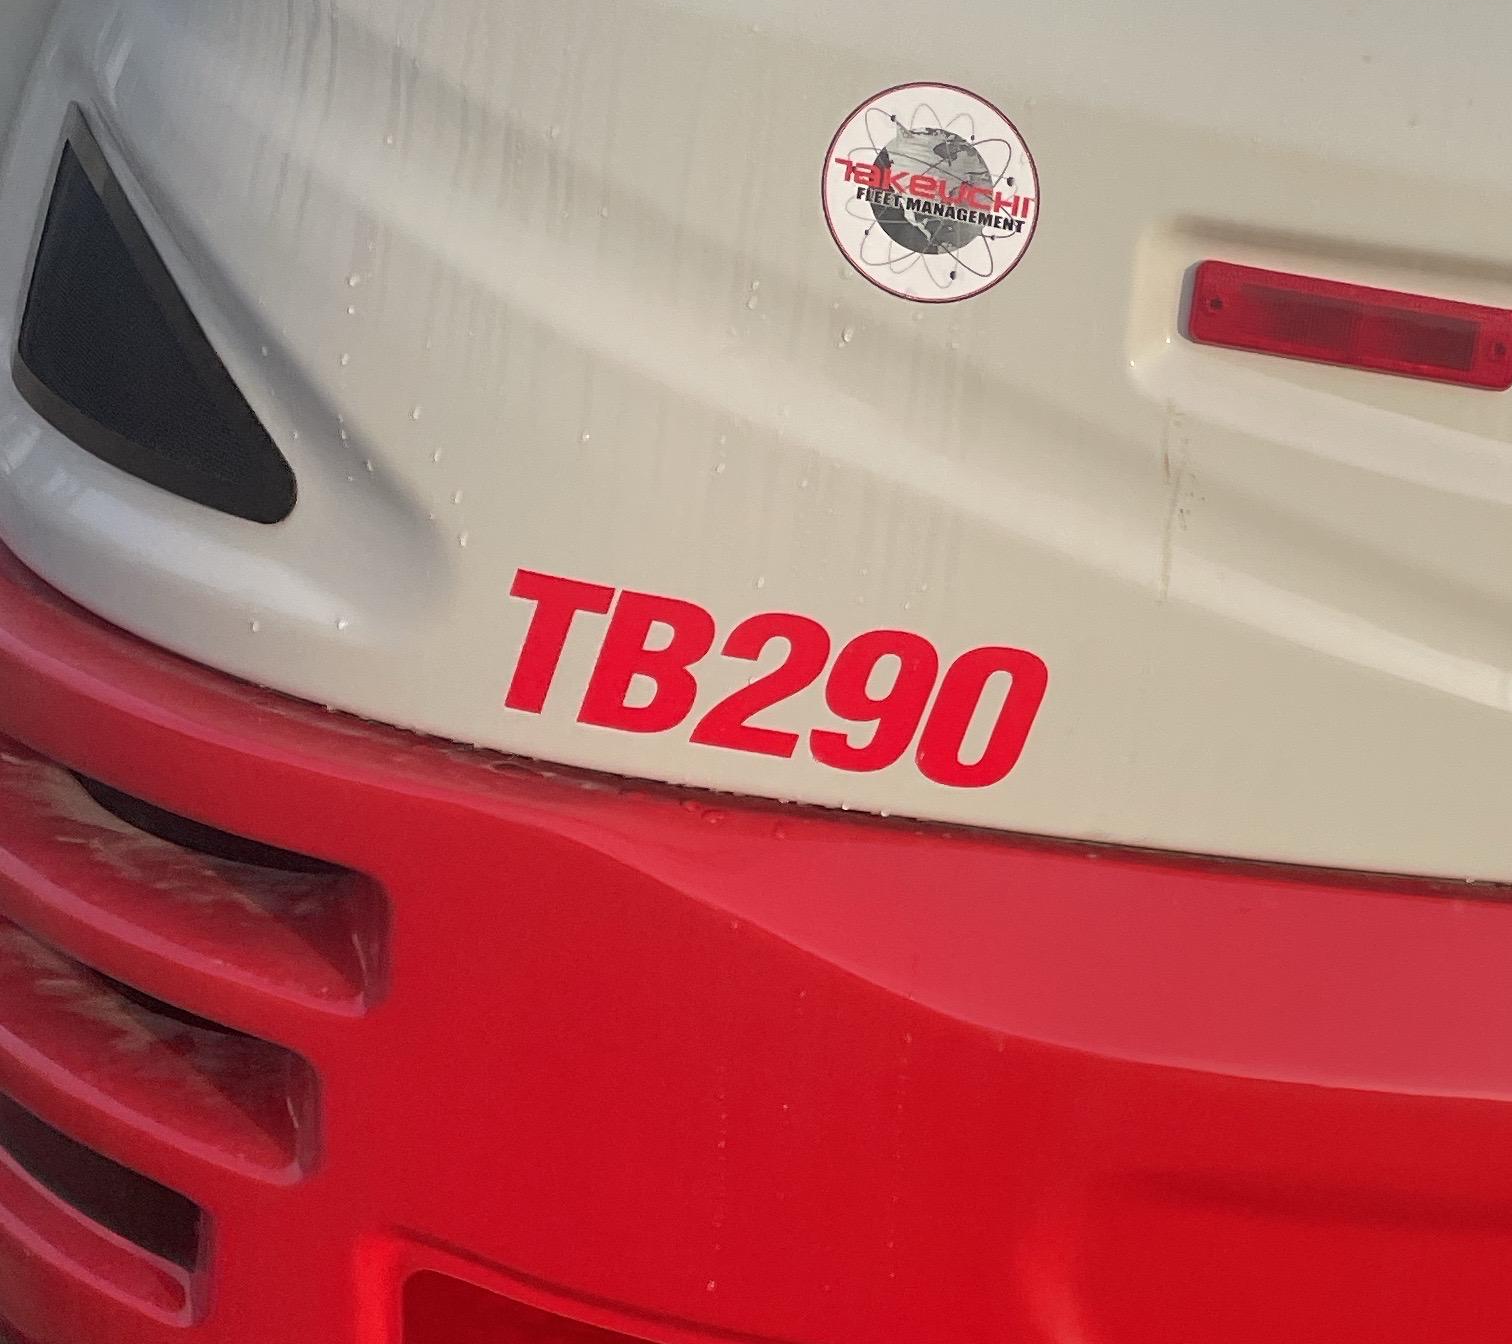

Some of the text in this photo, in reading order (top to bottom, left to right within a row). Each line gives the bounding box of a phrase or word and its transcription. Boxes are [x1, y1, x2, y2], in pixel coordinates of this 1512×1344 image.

[856, 186, 1026, 234] FLEET MANAGEMENT
[504, 568, 1049, 788] TB290
